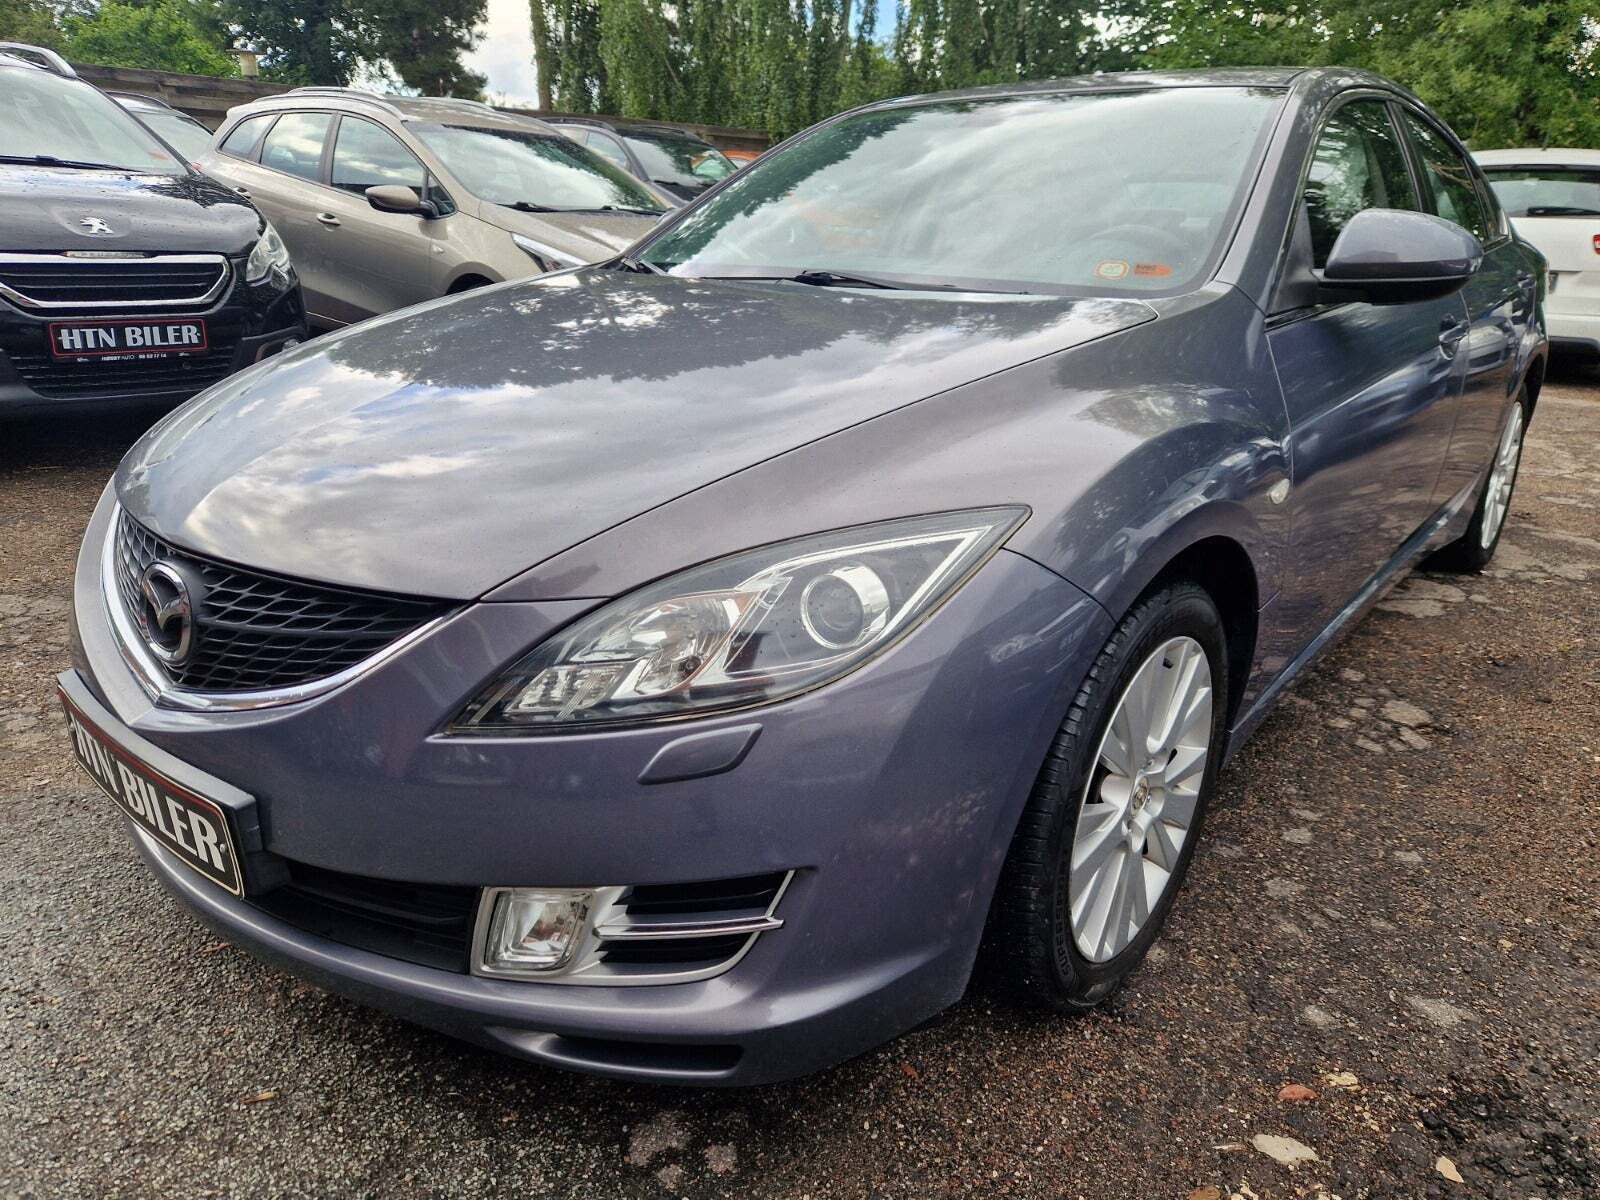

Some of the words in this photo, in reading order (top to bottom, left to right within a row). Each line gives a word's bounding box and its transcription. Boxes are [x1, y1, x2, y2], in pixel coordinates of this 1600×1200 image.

[60, 327, 116, 349] HTN
[124, 324, 200, 347] BILER
[70, 711, 120, 794] HTN
[117, 760, 226, 873] BILER
